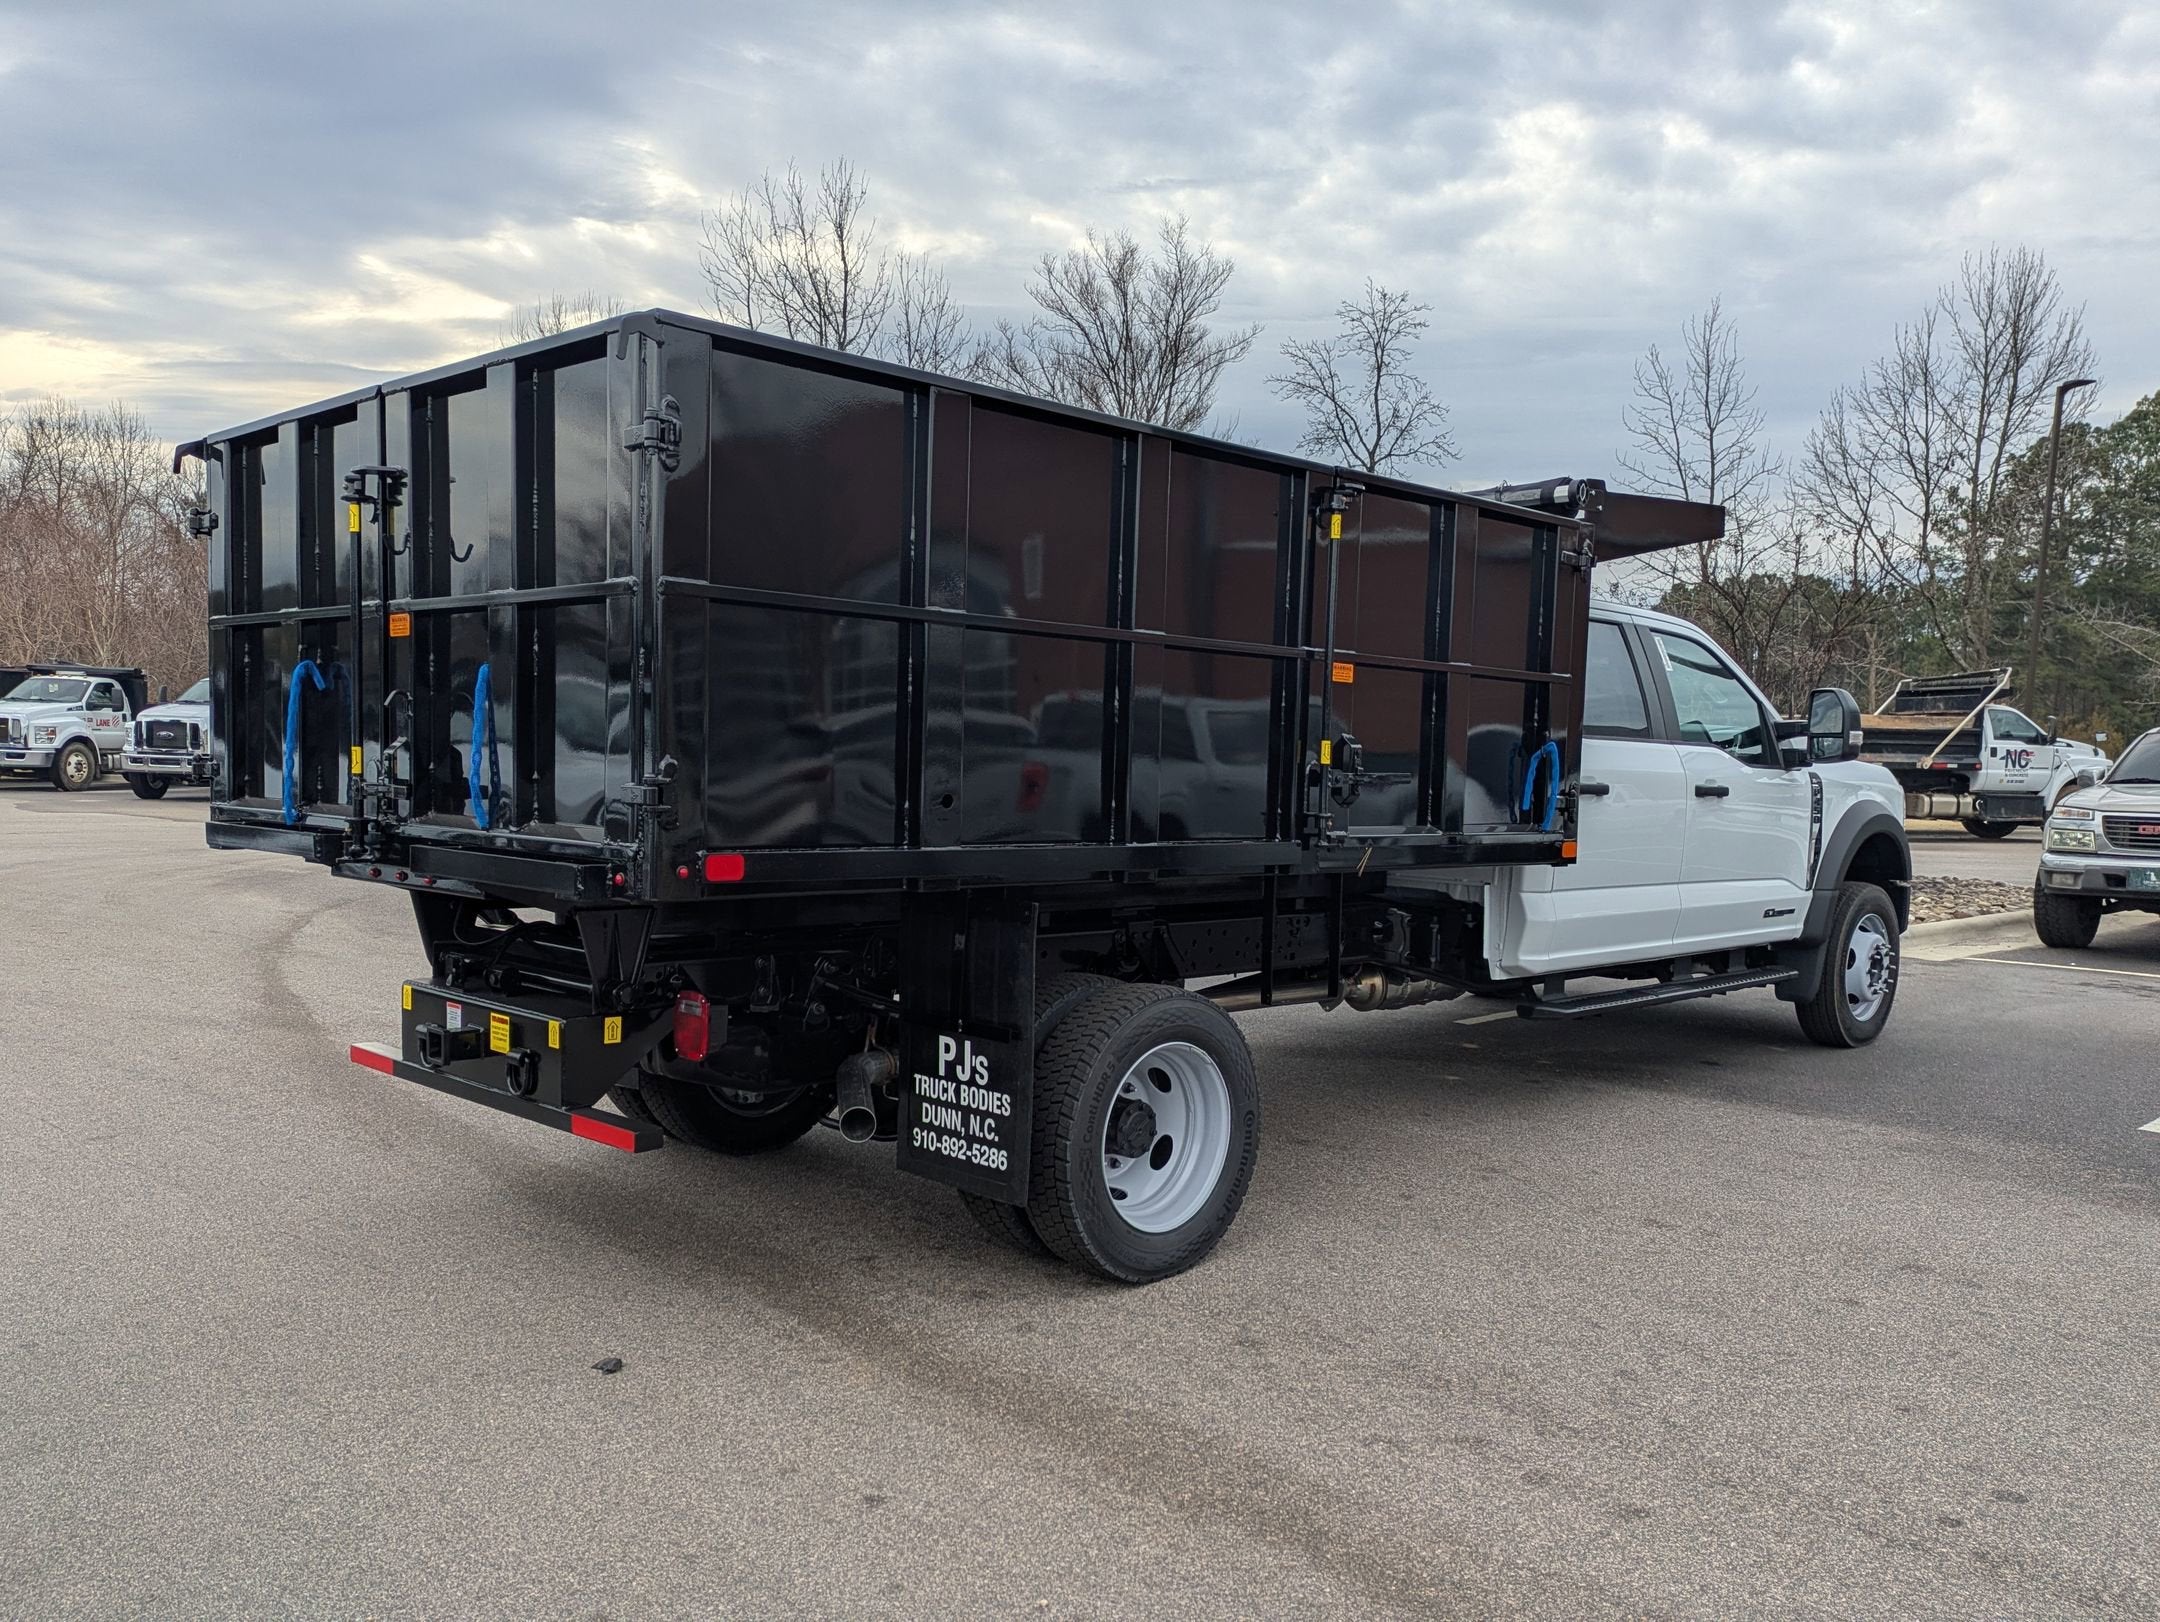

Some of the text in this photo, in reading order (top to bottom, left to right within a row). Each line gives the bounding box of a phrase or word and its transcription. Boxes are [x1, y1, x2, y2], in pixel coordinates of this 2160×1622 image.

[95, 719, 111, 727] LANE
[2005, 749, 2029, 769] NC
[913, 1073, 1011, 1117] TRUCK BODIES
[1083, 1104, 1098, 1143] Conti
[1092, 1072, 1111, 1104] HDR
[922, 1102, 999, 1142] DUNN, N.C.
[913, 1127, 1008, 1171] 910-892-5286
[1223, 1110, 1255, 1213] Continental
